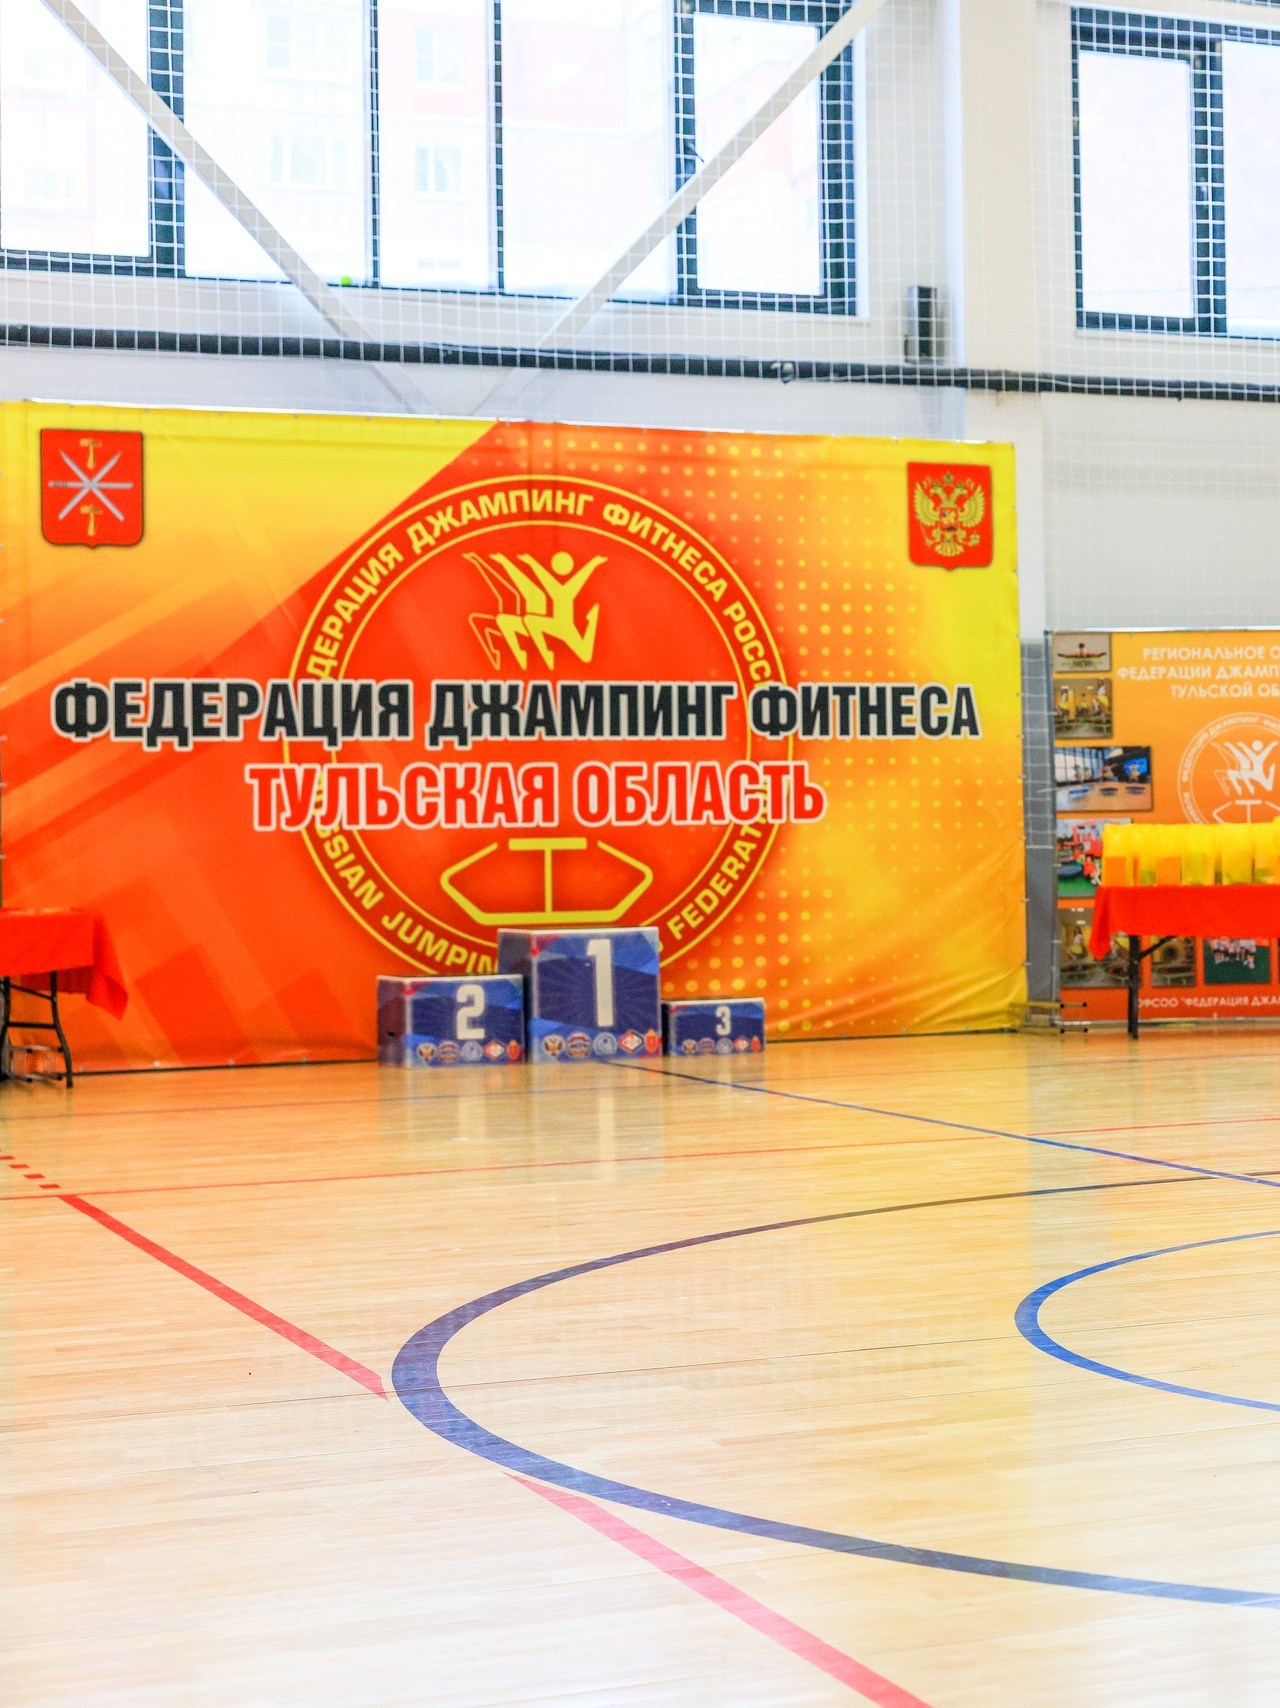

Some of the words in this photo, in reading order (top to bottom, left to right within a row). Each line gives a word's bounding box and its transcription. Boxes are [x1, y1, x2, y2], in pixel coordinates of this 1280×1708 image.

[306, 542, 404, 681] ДЕРАЦИЯ
[406, 489, 594, 554] ДЖАМПИНГ
[602, 503, 728, 602] ФИТНЕСА
[722, 601, 775, 688] РОСС
[1117, 665, 1212, 681] ФЕДЕРАЦИИ
[1142, 647, 1265, 661] РЕГИОНАЛЬНОЕ
[52, 678, 413, 750] ФЕДЕРАЦИЯ
[426, 680, 736, 750] ДЖАМПИНГ
[750, 683, 981, 740] ФИТНЕСА
[1170, 682, 1253, 699] ТУЛЬСКОЙ
[245, 762, 559, 831] ТУЛЬСКАЯ
[573, 761, 826, 826] ОБЛАСТЬ
[381, 911, 498, 975] JUMPIN
[667, 779, 768, 940] FEDERAT
[456, 984, 486, 1040] 2
[587, 939, 614, 1027] 1
[716, 1006, 732, 1035] 3
